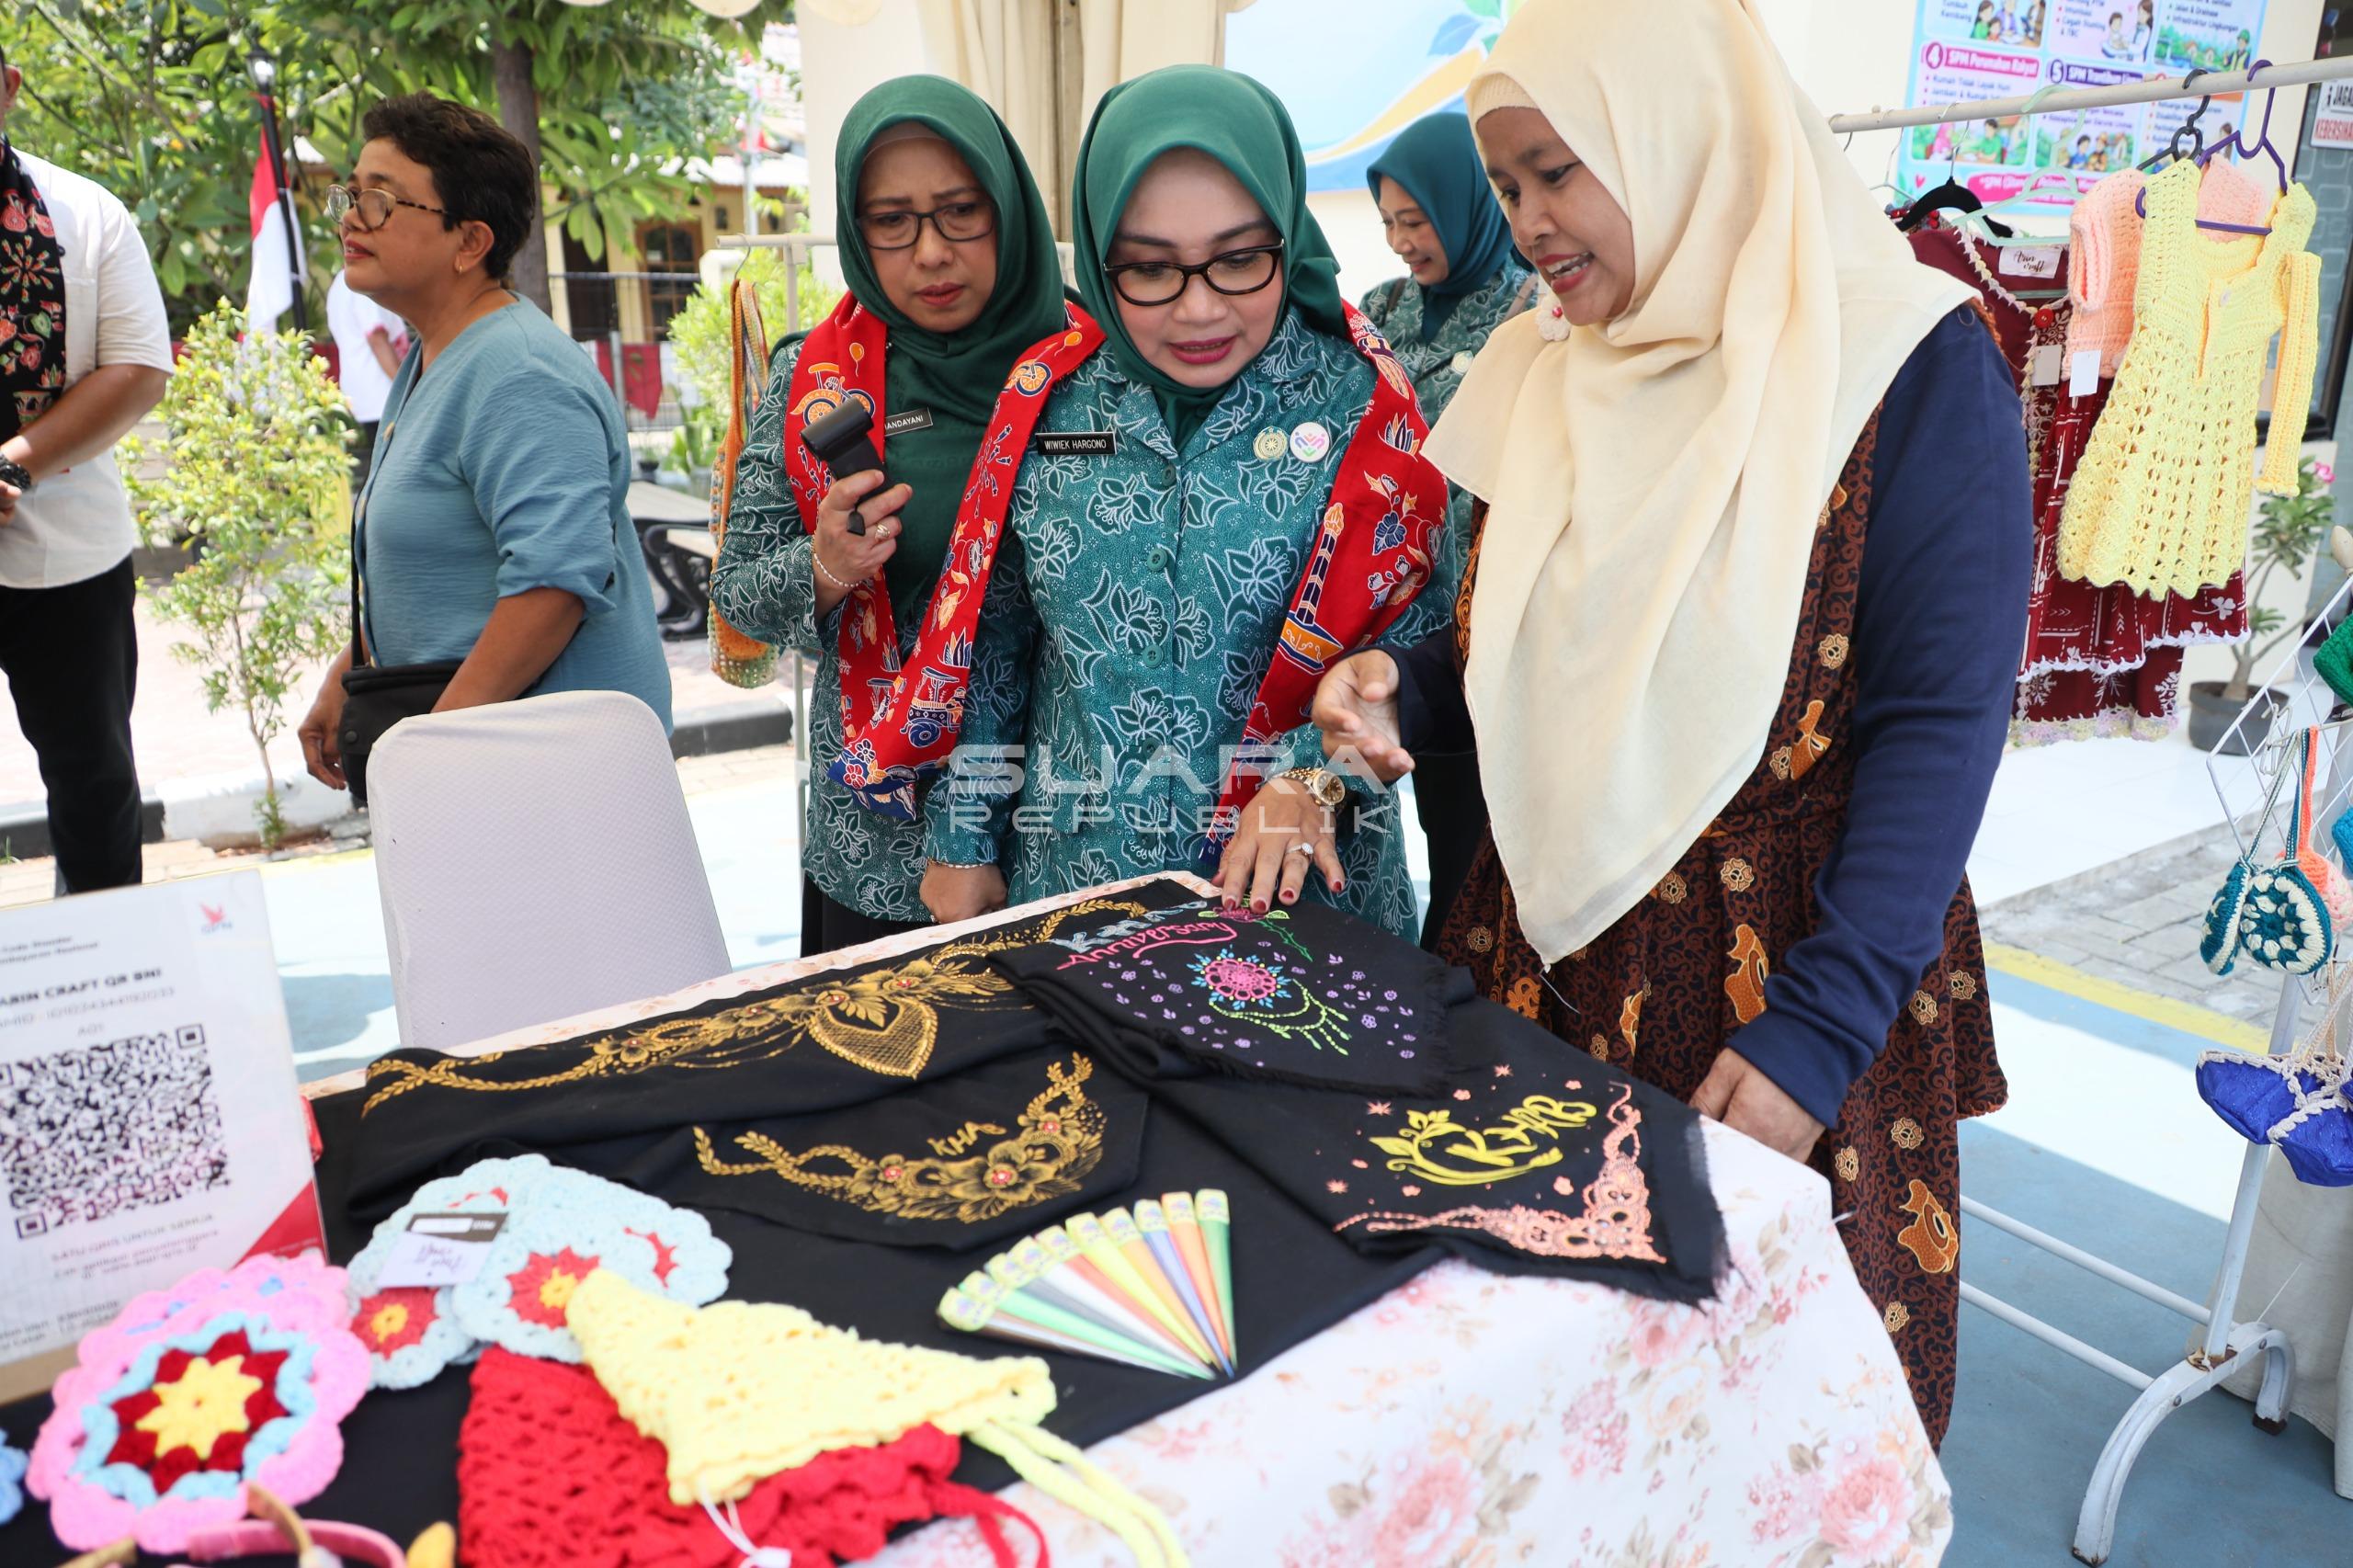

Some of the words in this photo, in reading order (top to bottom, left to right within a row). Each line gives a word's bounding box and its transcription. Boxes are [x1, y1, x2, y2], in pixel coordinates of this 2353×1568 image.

[884, 415, 924, 430] ANDAYANI
[1043, 440, 1070, 450] WIWIEK
[1072, 438, 1107, 449] HARGONO
[44, 979, 99, 1000] CRAFT
[133, 967, 163, 983] BNI
